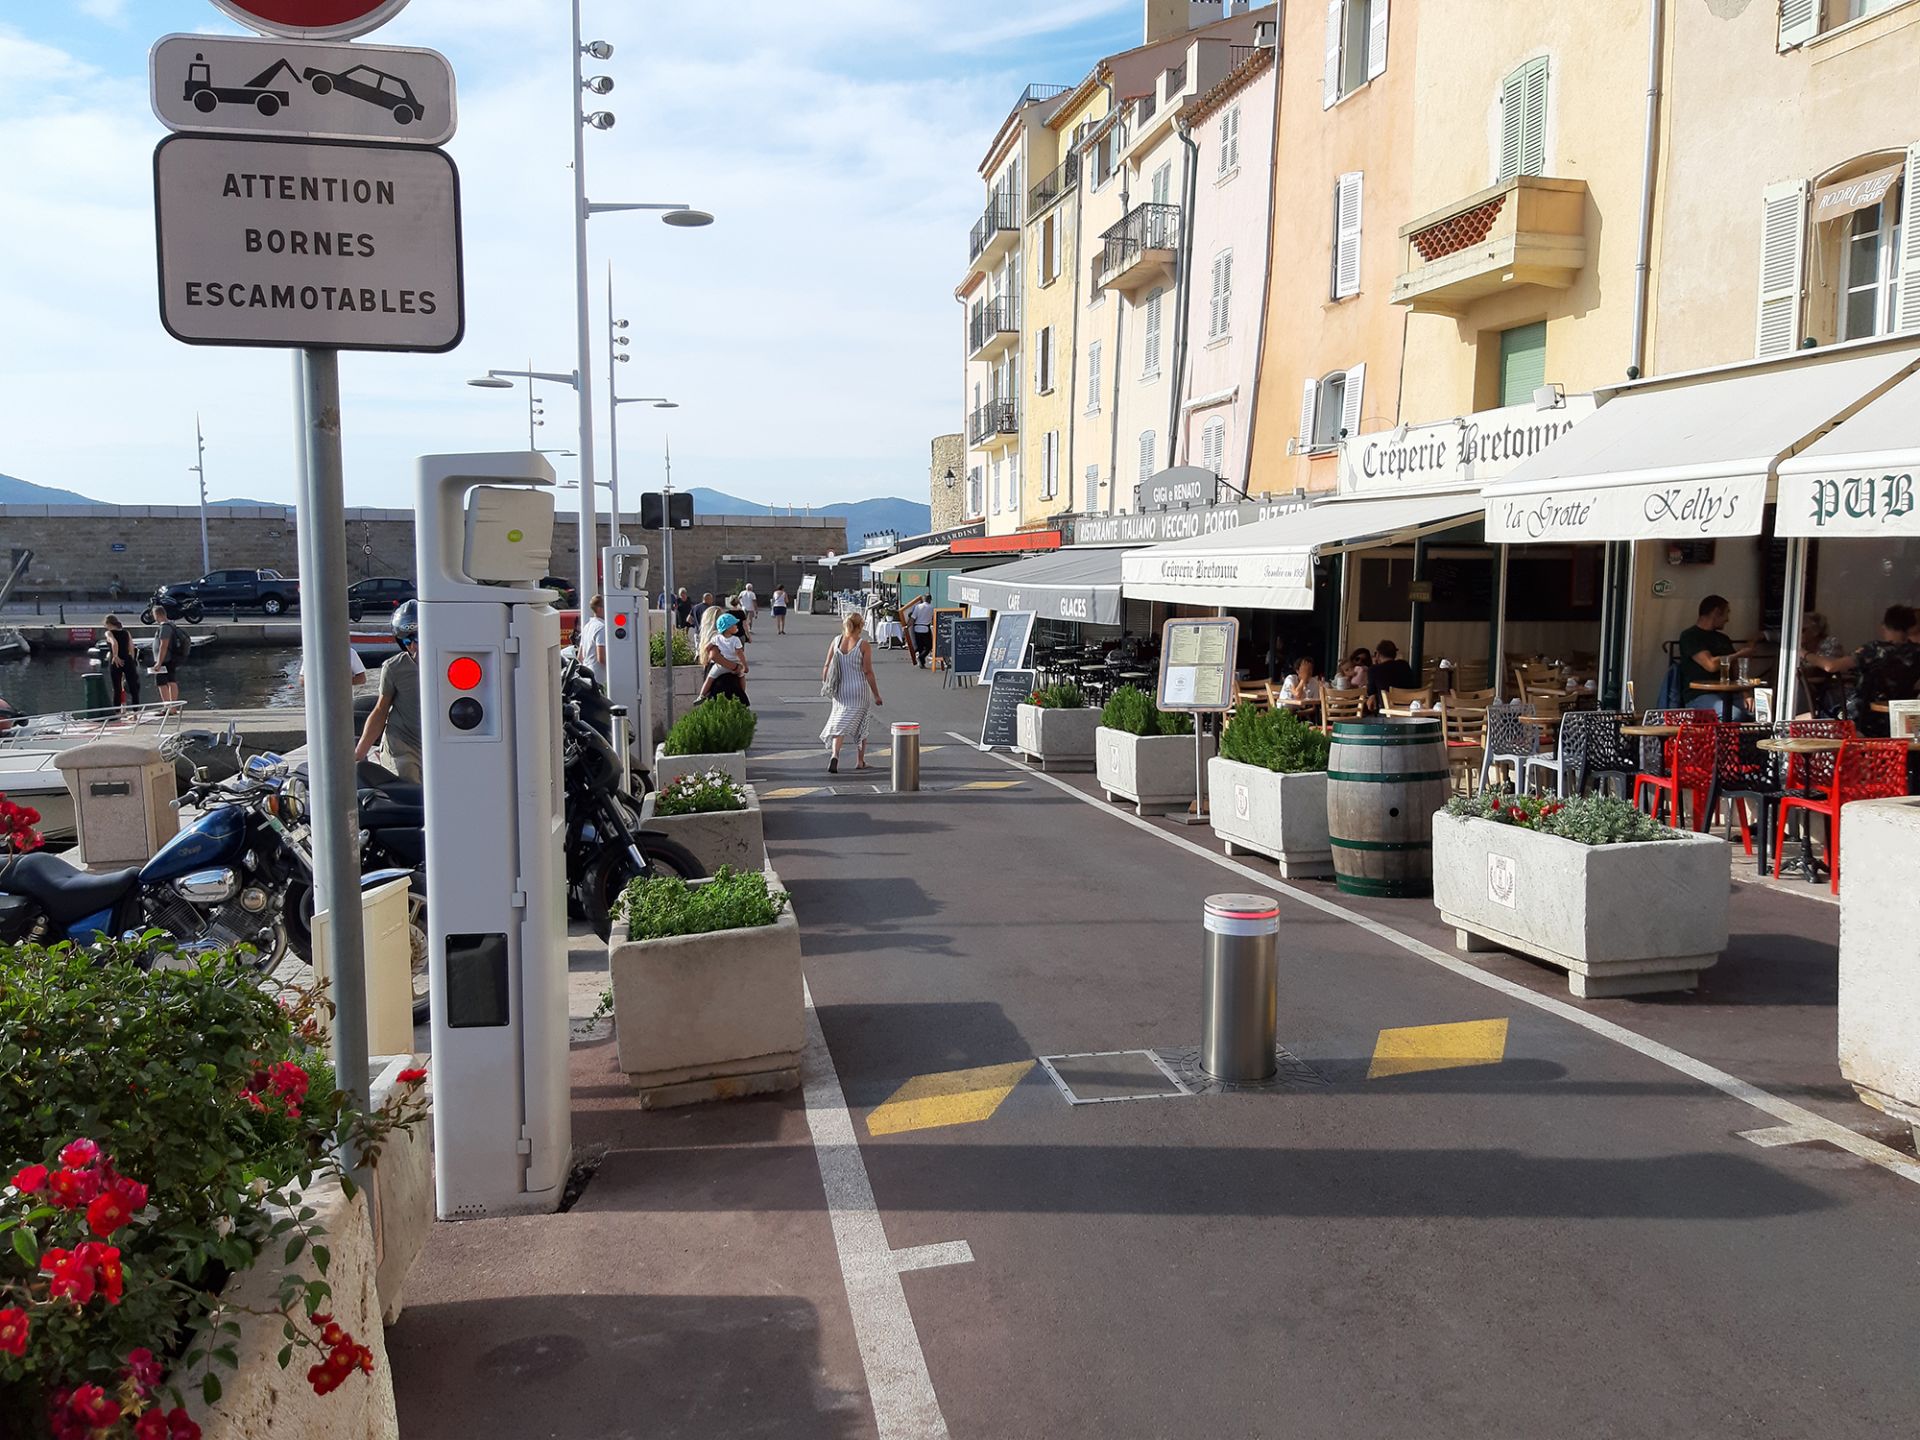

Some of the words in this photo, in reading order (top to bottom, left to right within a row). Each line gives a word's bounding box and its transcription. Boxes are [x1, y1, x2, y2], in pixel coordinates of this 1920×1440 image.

[222, 173, 395, 205] ATTENTION
[1818, 173, 1894, 209] RODRIGUEZ
[245, 229, 376, 258] BORNES
[185, 282, 437, 315] ESCAMOTABLES
[1363, 434, 1447, 480] Crêperie
[1153, 487, 1167, 503] GIGI
[1173, 484, 1201, 501] RENATO
[1643, 486, 1739, 533] Kelly's
[1808, 473, 1914, 526] PUB
[941, 527, 978, 543] SARDINE
[1080, 520, 1118, 542] RISTORANTE
[1121, 517, 1156, 540] ITALIANO
[1161, 513, 1199, 539] VECCHIO
[1204, 509, 1239, 535] PORTO
[1161, 560, 1193, 582] Crêperie
[1195, 560, 1239, 580] Bretonne
[1008, 591, 1021, 610] CAFÉ
[1060, 597, 1087, 618] GLACES
